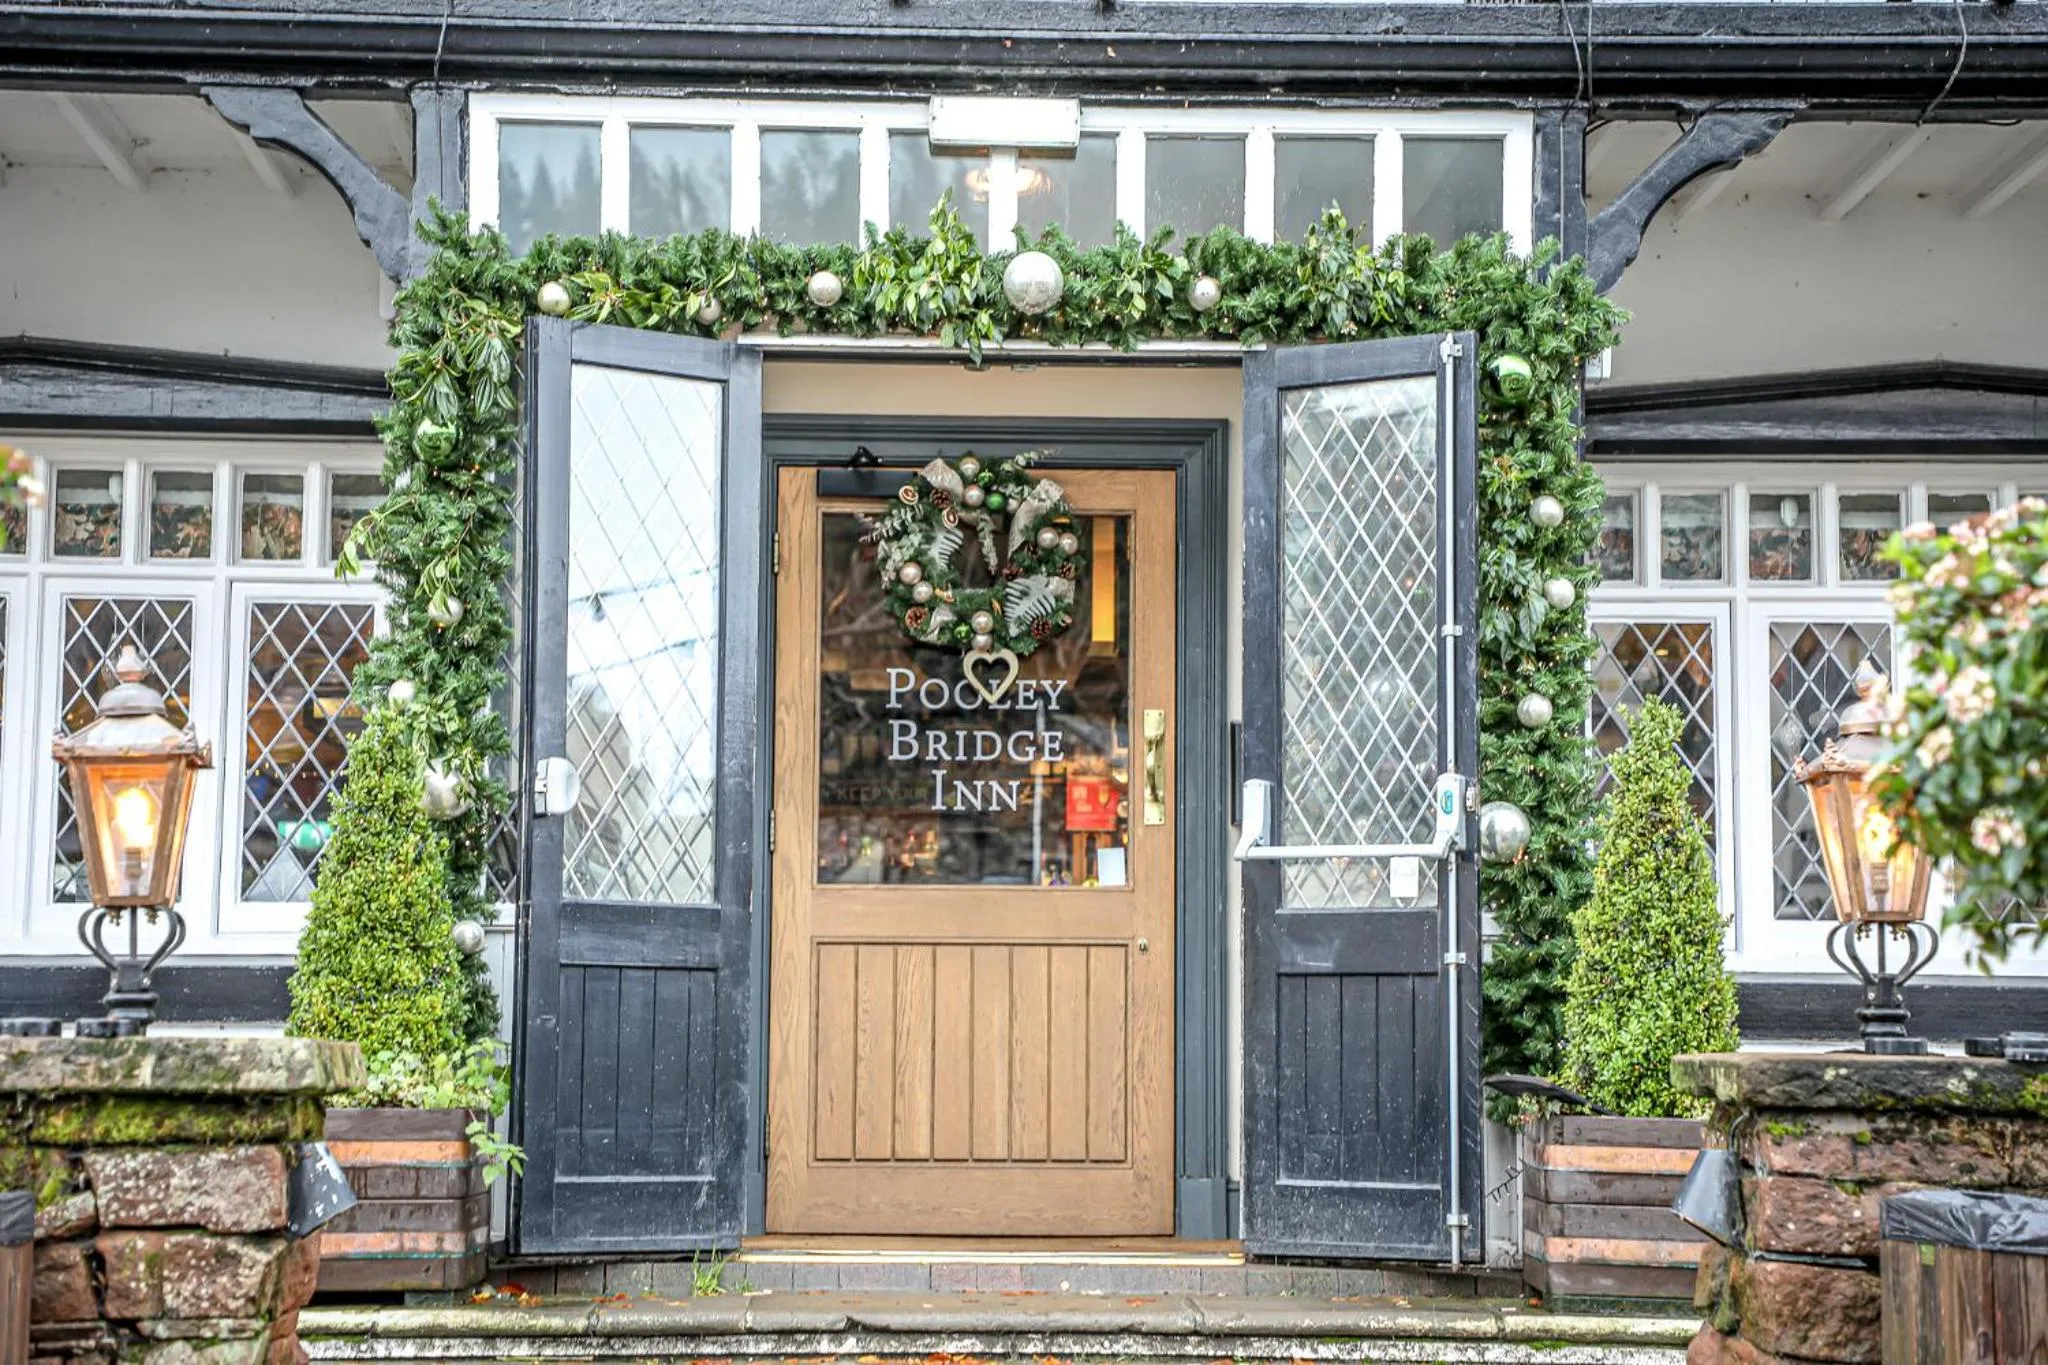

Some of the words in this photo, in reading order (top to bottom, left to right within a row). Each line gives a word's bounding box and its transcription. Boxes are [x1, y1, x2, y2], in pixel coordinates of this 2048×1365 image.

[885, 667, 1068, 710] POOLEY
[888, 719, 1065, 761] BRIDGE
[931, 769, 1020, 812] INN
